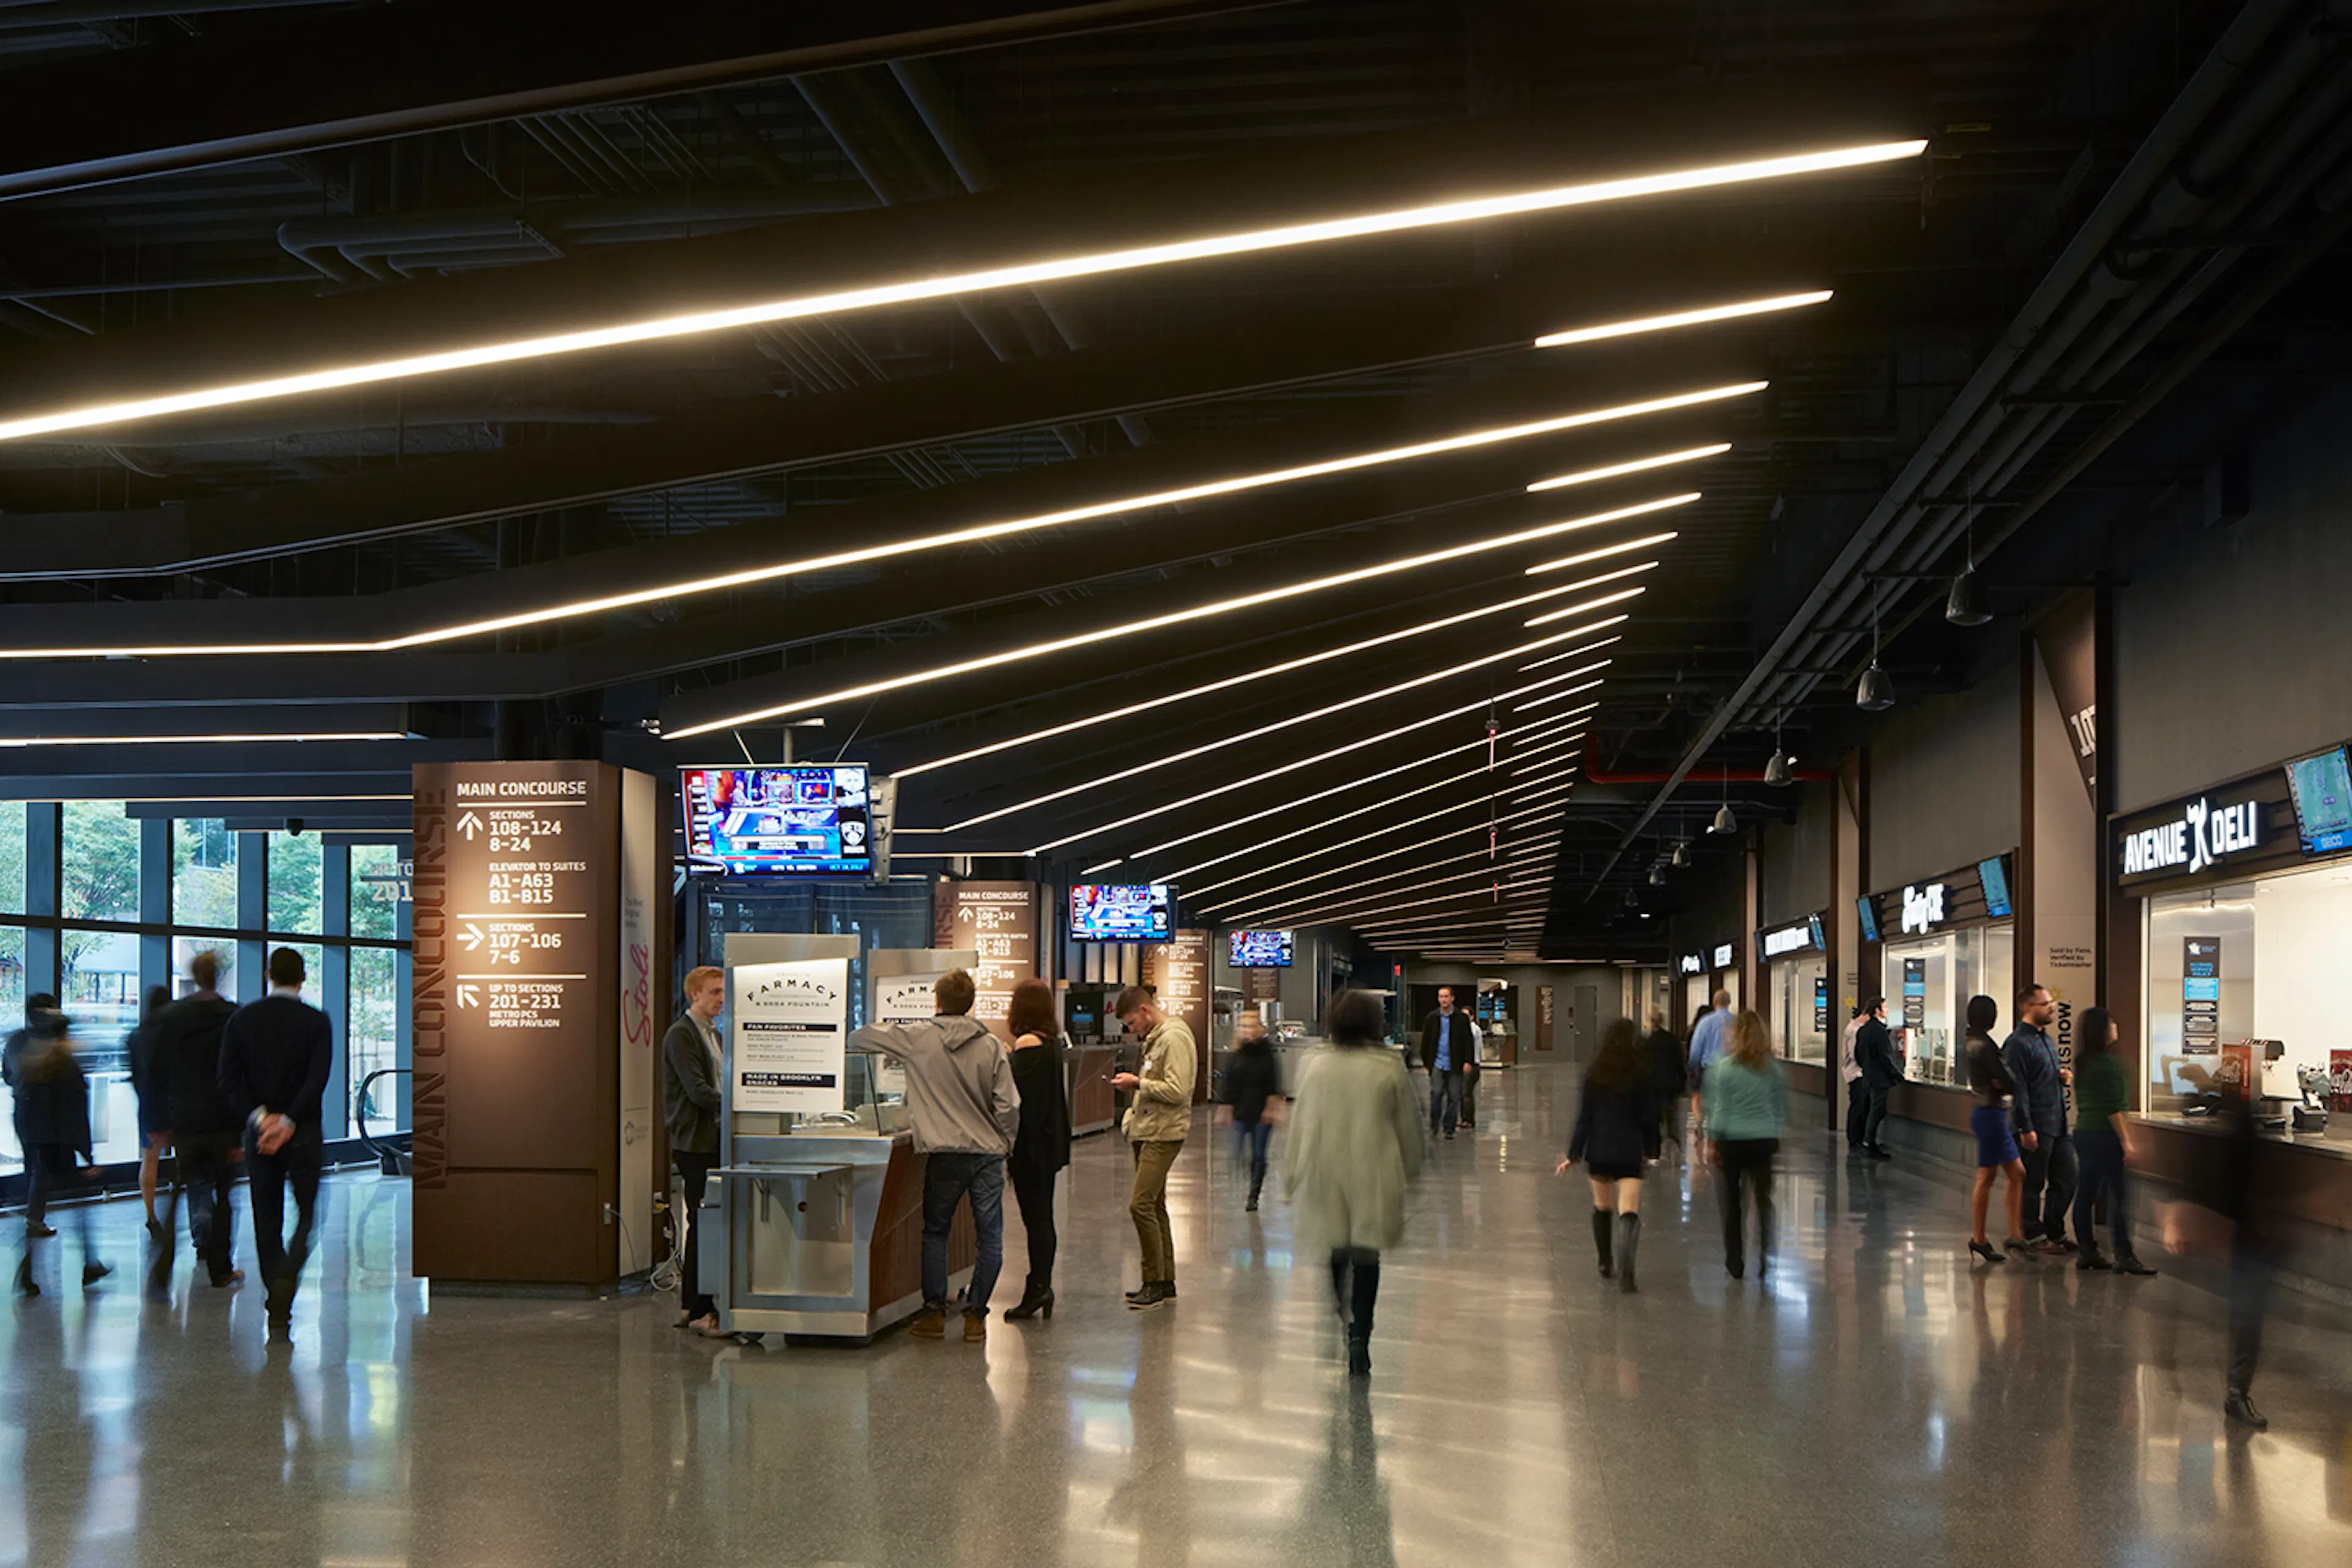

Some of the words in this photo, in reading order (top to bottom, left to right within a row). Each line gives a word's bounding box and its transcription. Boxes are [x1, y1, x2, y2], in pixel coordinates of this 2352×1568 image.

[457, 783, 496, 796] MAIN
[499, 782, 587, 795] CONCOURSE
[489, 810, 535, 820] SECTIONS
[489, 821, 562, 835] 108-124
[489, 837, 532, 851] 8-24
[2124, 820, 2188, 875] AVENUE
[2211, 801, 2257, 855] DELI
[489, 862, 537, 872] ELEVATOR
[538, 862, 551, 871] TO
[552, 862, 586, 871] SUITES
[489, 873, 554, 888] A1-A63
[489, 889, 554, 904] B1-B15
[412, 787, 447, 1058] CONCOURSE
[489, 923, 535, 932] SECTIONS
[489, 933, 562, 948] 107-106
[489, 950, 520, 964] 7-6
[489, 984, 502, 993] UP
[503, 984, 517, 993] TO
[518, 984, 564, 993] SECTIONS
[747, 979, 837, 1001] FARMACY
[489, 994, 561, 1009] 201-231
[520, 1019, 560, 1027] PAVILION
[412, 1072, 447, 1190] MAIN
